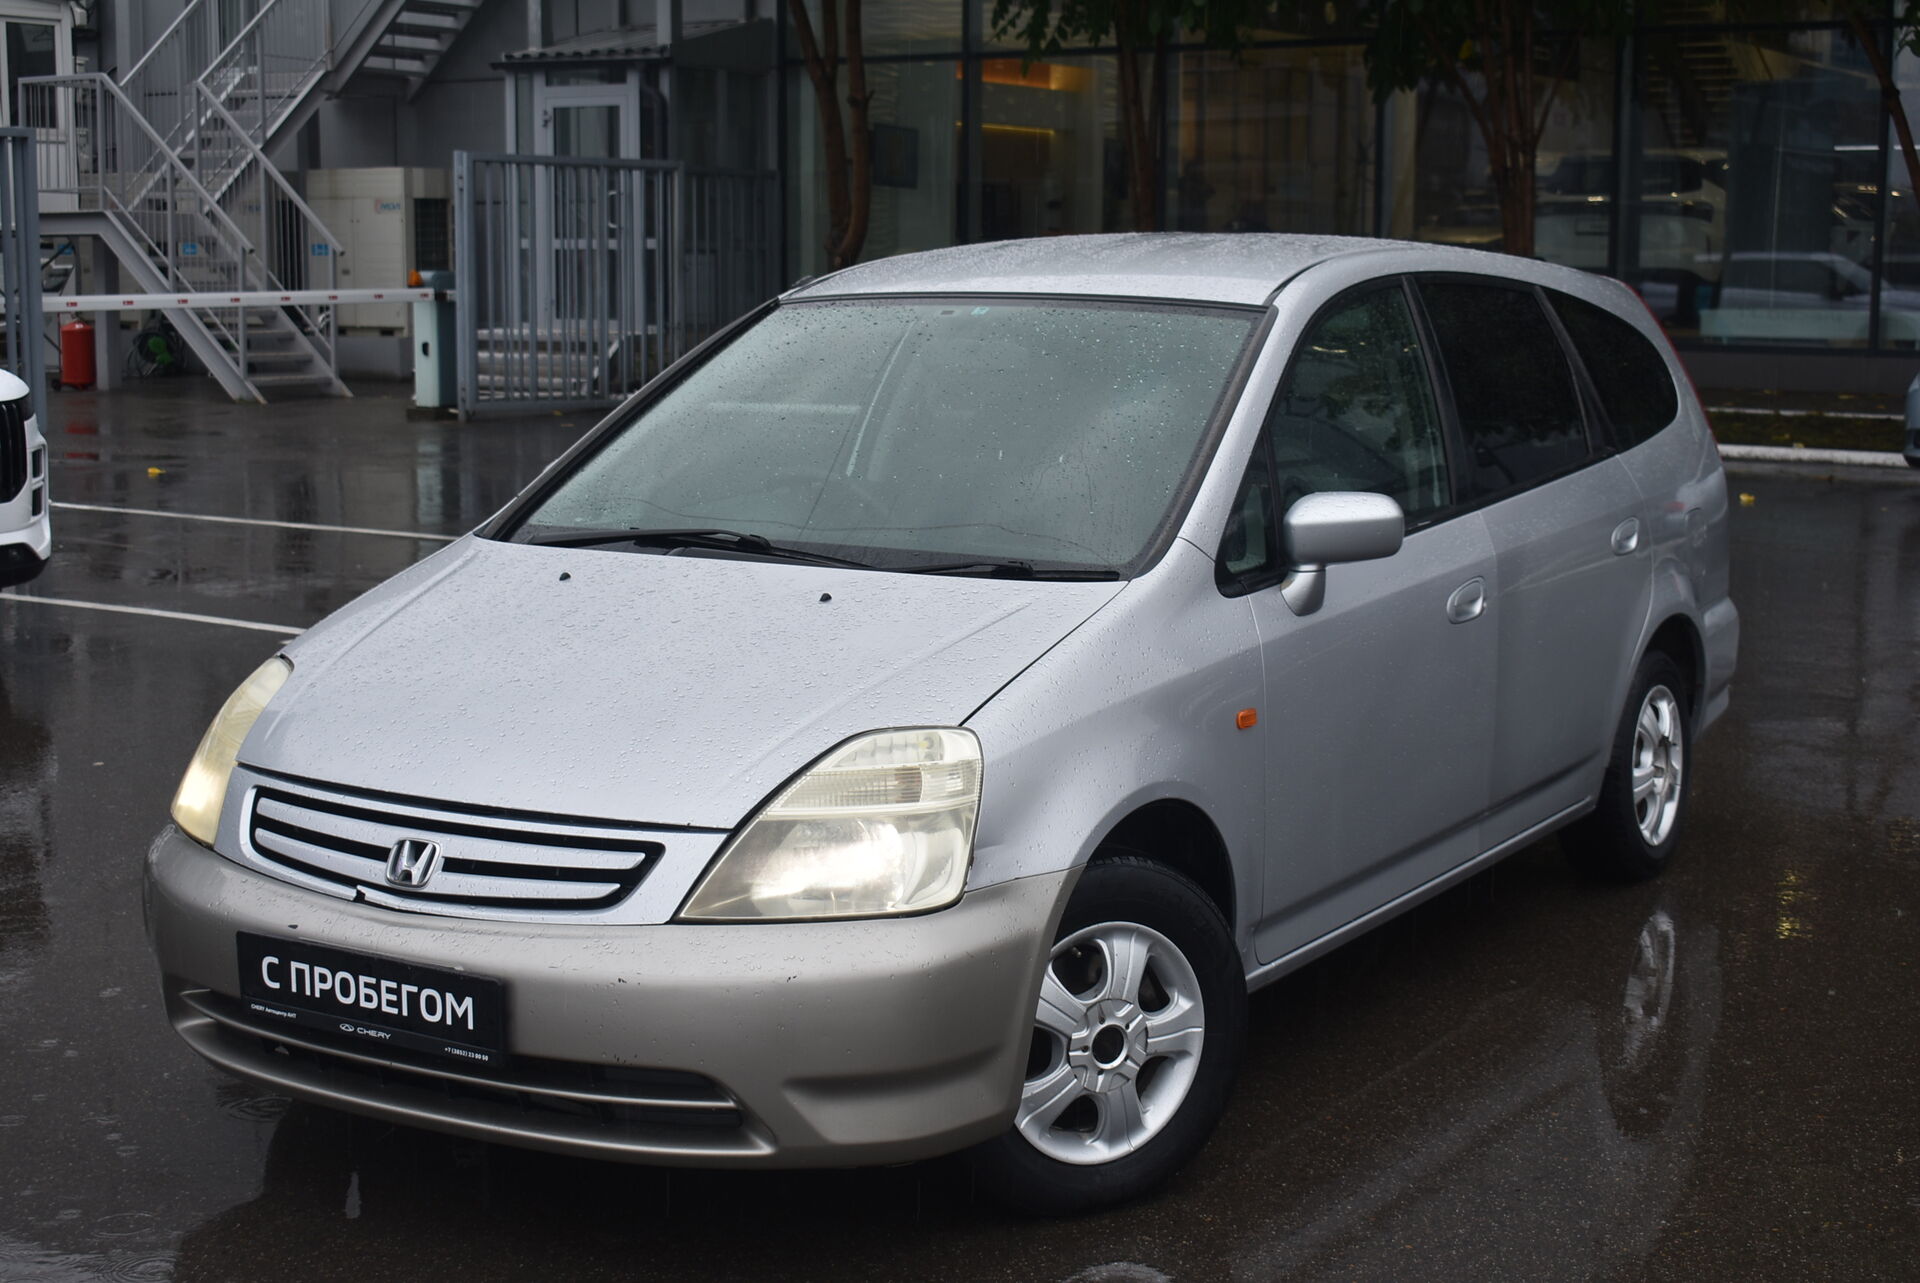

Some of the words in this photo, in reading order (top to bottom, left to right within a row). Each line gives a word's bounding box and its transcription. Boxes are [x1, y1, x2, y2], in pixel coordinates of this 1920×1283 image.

[261, 956, 280, 989] С
[290, 960, 474, 1030] ПРОБЕГОМ
[356, 1026, 391, 1039] CHERY
